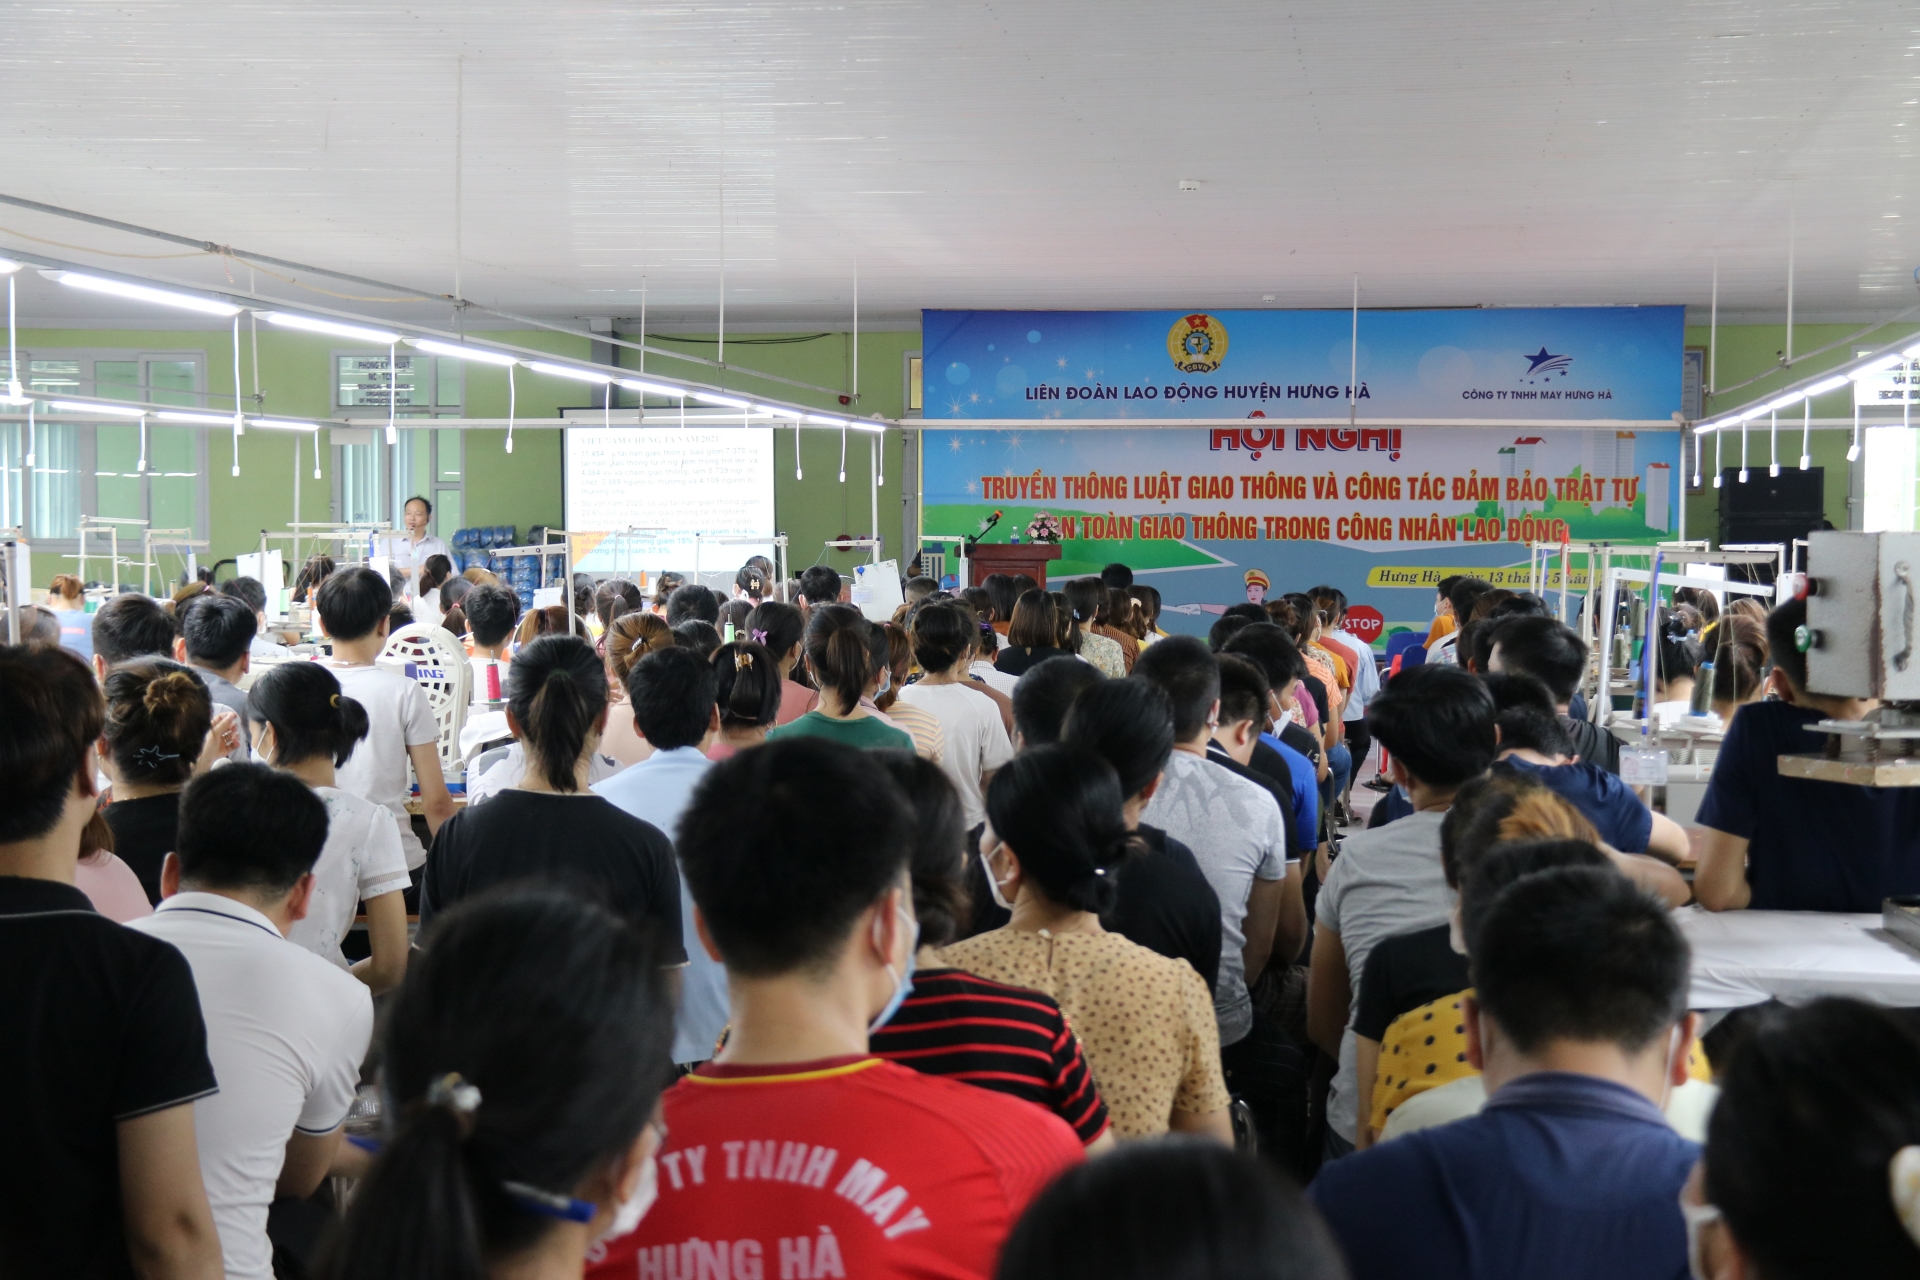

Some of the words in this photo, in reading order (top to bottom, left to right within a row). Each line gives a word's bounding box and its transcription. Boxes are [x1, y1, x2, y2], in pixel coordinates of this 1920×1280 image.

[1026, 383, 1060, 400] LIÊN
[1066, 382, 1118, 400] ĐOÀN
[1124, 386, 1158, 399] LAO
[1164, 382, 1218, 403] ĐỘNG
[1224, 382, 1281, 402] HUYỆN
[1287, 383, 1339, 399] HƯNG
[1345, 382, 1370, 399] HÀ
[1462, 389, 1494, 399] CÔNG
[1496, 390, 1508, 399] TY
[1511, 390, 1537, 399] TNHH
[1540, 390, 1562, 399] MAY
[1565, 389, 1595, 399] HƯNG
[1598, 389, 1612, 399] HÀ
[1210, 410, 1285, 461] HỘI
[1296, 428, 1402, 461] NGHỊ
[981, 469, 1057, 500] TRUYỀN
[1062, 471, 1128, 500] THÔNG
[1133, 471, 1182, 504] LUẬT
[1187, 475, 1234, 500] GIAO
[1240, 471, 1307, 500] THÔNG
[1313, 471, 1339, 500] VÀ
[1345, 471, 1401, 501] CÔNG
[1407, 472, 1446, 501] TÁC
[1451, 469, 1499, 501] ĐẢM
[1506, 469, 1548, 501] BẢO
[1554, 472, 1605, 507] TRẬT
[1611, 475, 1640, 507] TỰ
[1081, 511, 1133, 540] TOÀN
[1139, 516, 1186, 540] GIAO
[1191, 511, 1257, 540] THÔNG
[1263, 516, 1330, 540] TRONG
[1336, 512, 1393, 541] CÔNG
[1399, 512, 1460, 541] NHÂN
[1462, 517, 1501, 541] LAO
[1507, 514, 1565, 547] ĐỘNG
[1379, 570, 1418, 585] Hưng
[1489, 571, 1504, 583] 13
[1552, 572, 1561, 583] 5
[1344, 618, 1381, 631] STOP
[661, 1144, 707, 1190] TY
[722, 1139, 838, 1189] TNHH
[834, 1157, 931, 1239] MAY
[637, 1237, 764, 1280] HƯNG
[779, 1224, 846, 1280] HÀ
